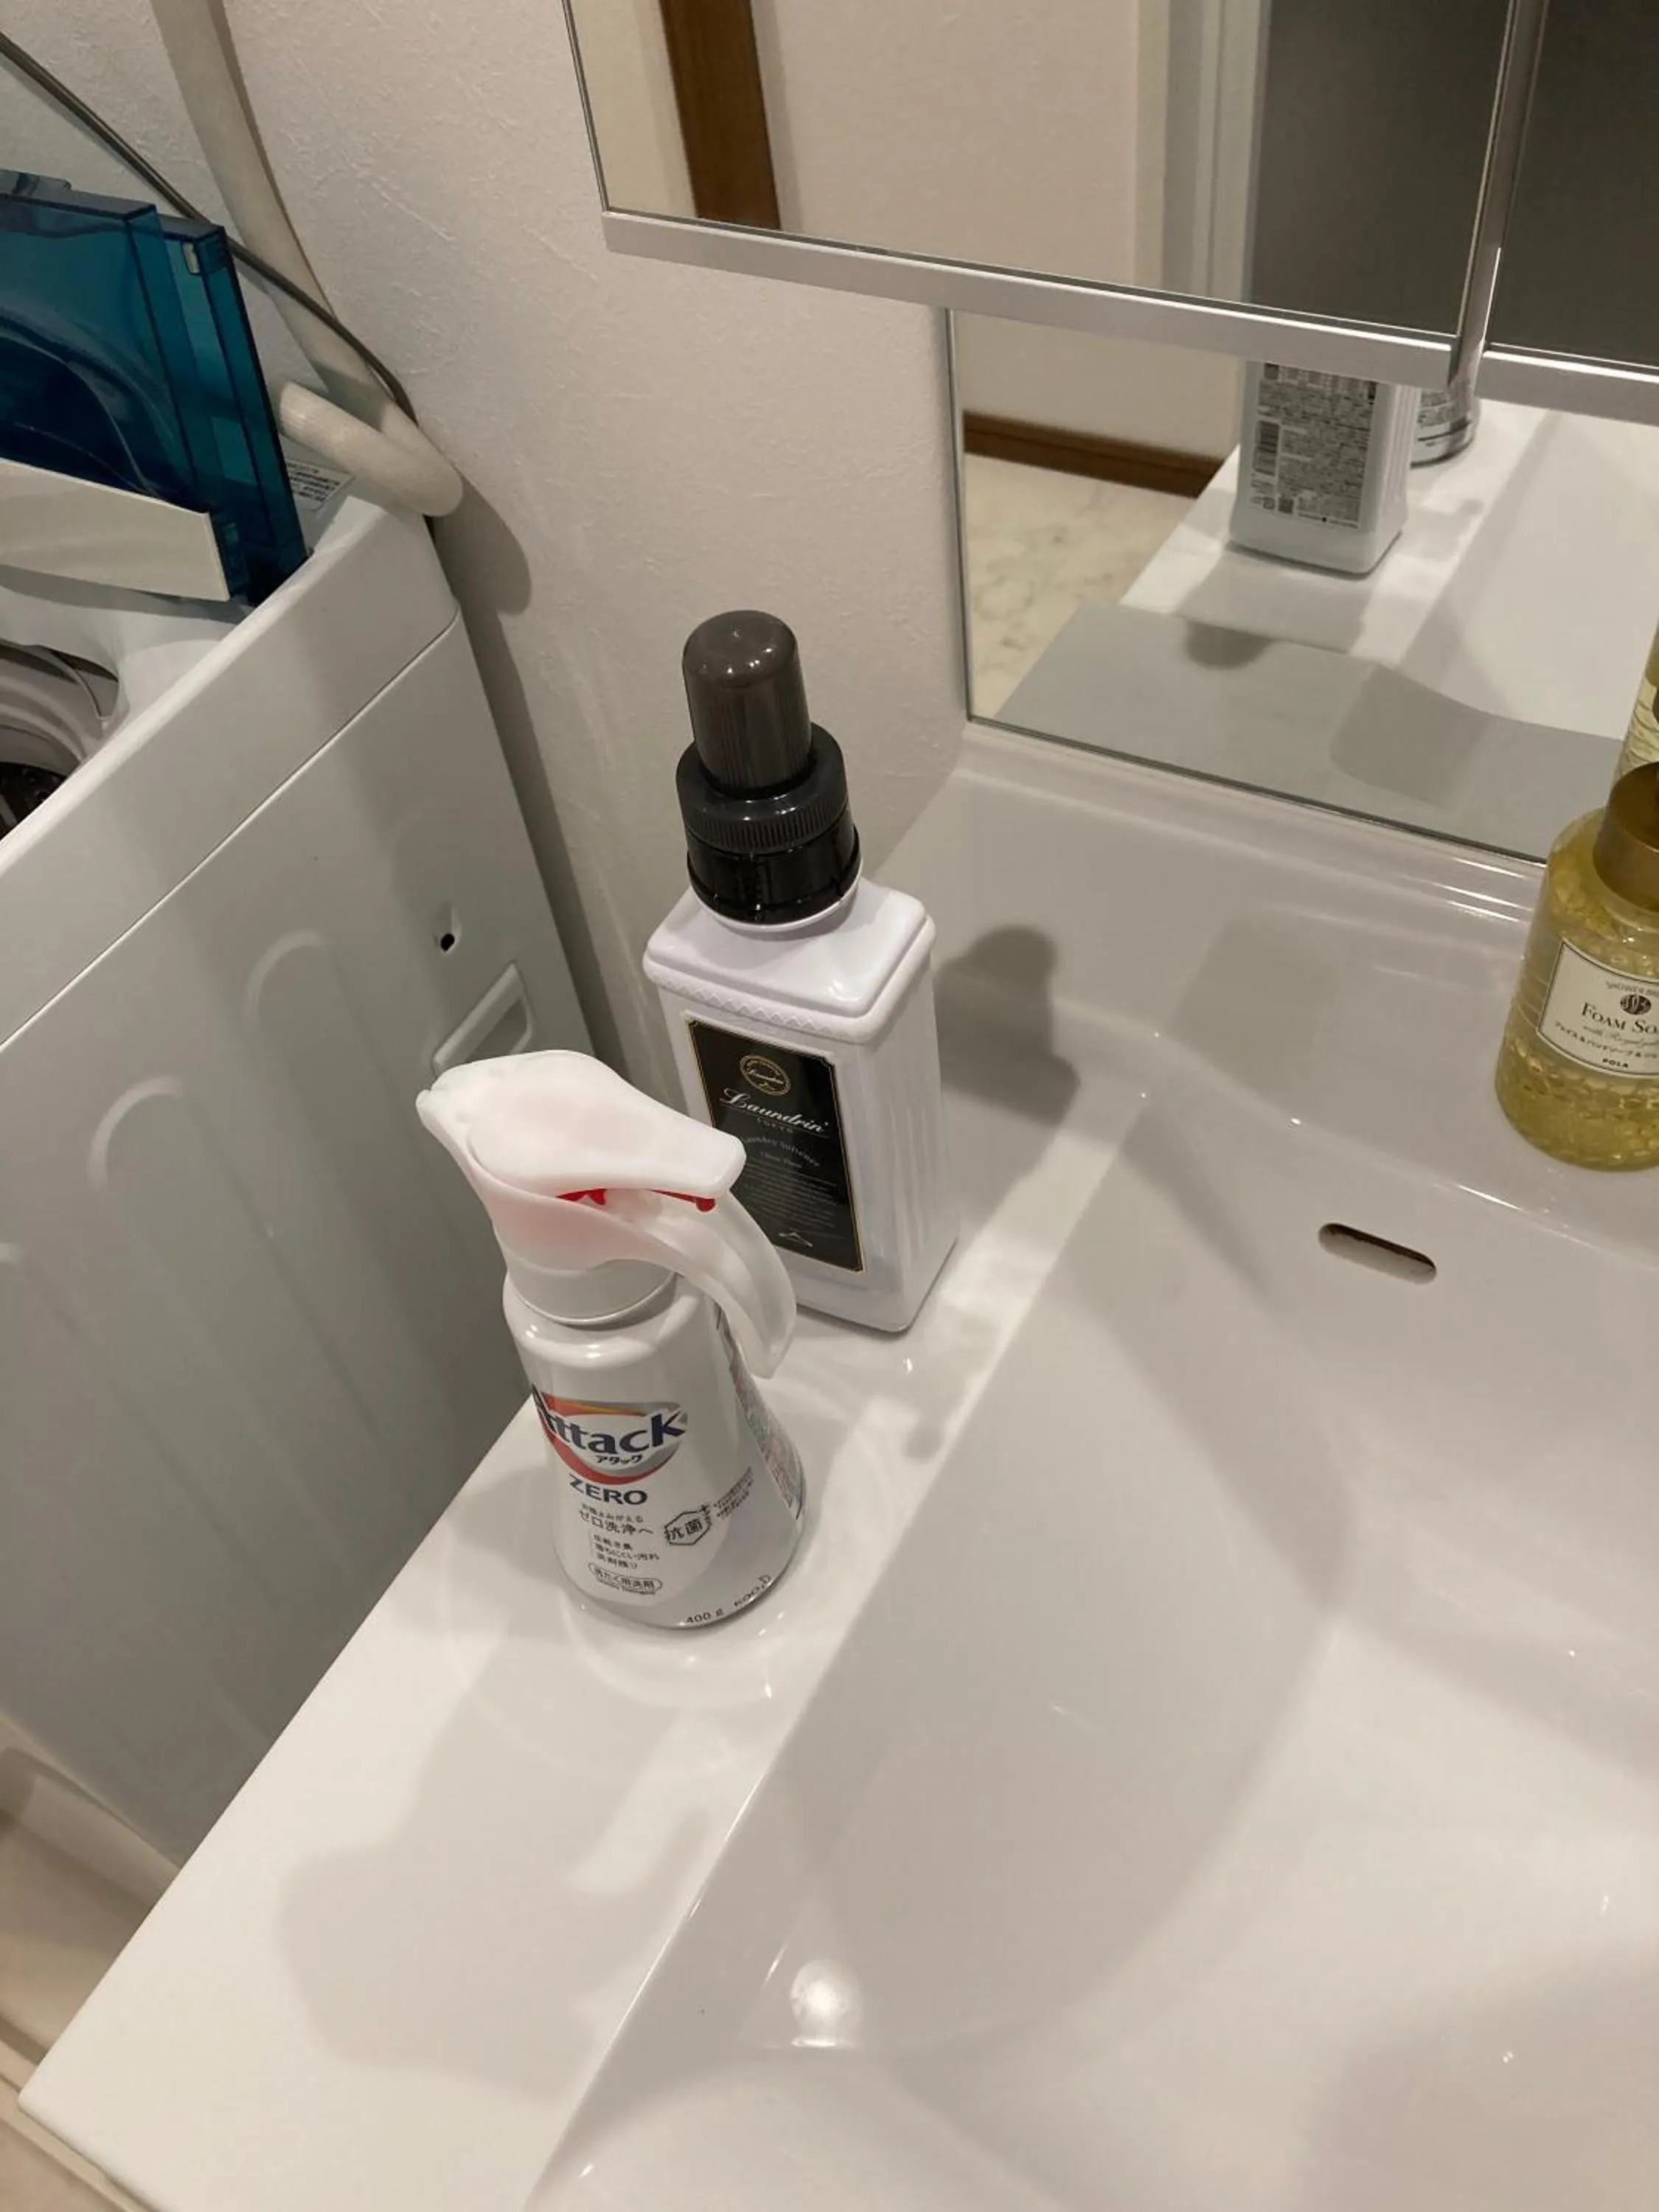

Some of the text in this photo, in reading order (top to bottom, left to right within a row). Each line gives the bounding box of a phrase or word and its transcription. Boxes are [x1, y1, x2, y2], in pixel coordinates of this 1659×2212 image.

[595, 1455, 643, 1465] アタック
[568, 1472, 648, 1506] ZERO
